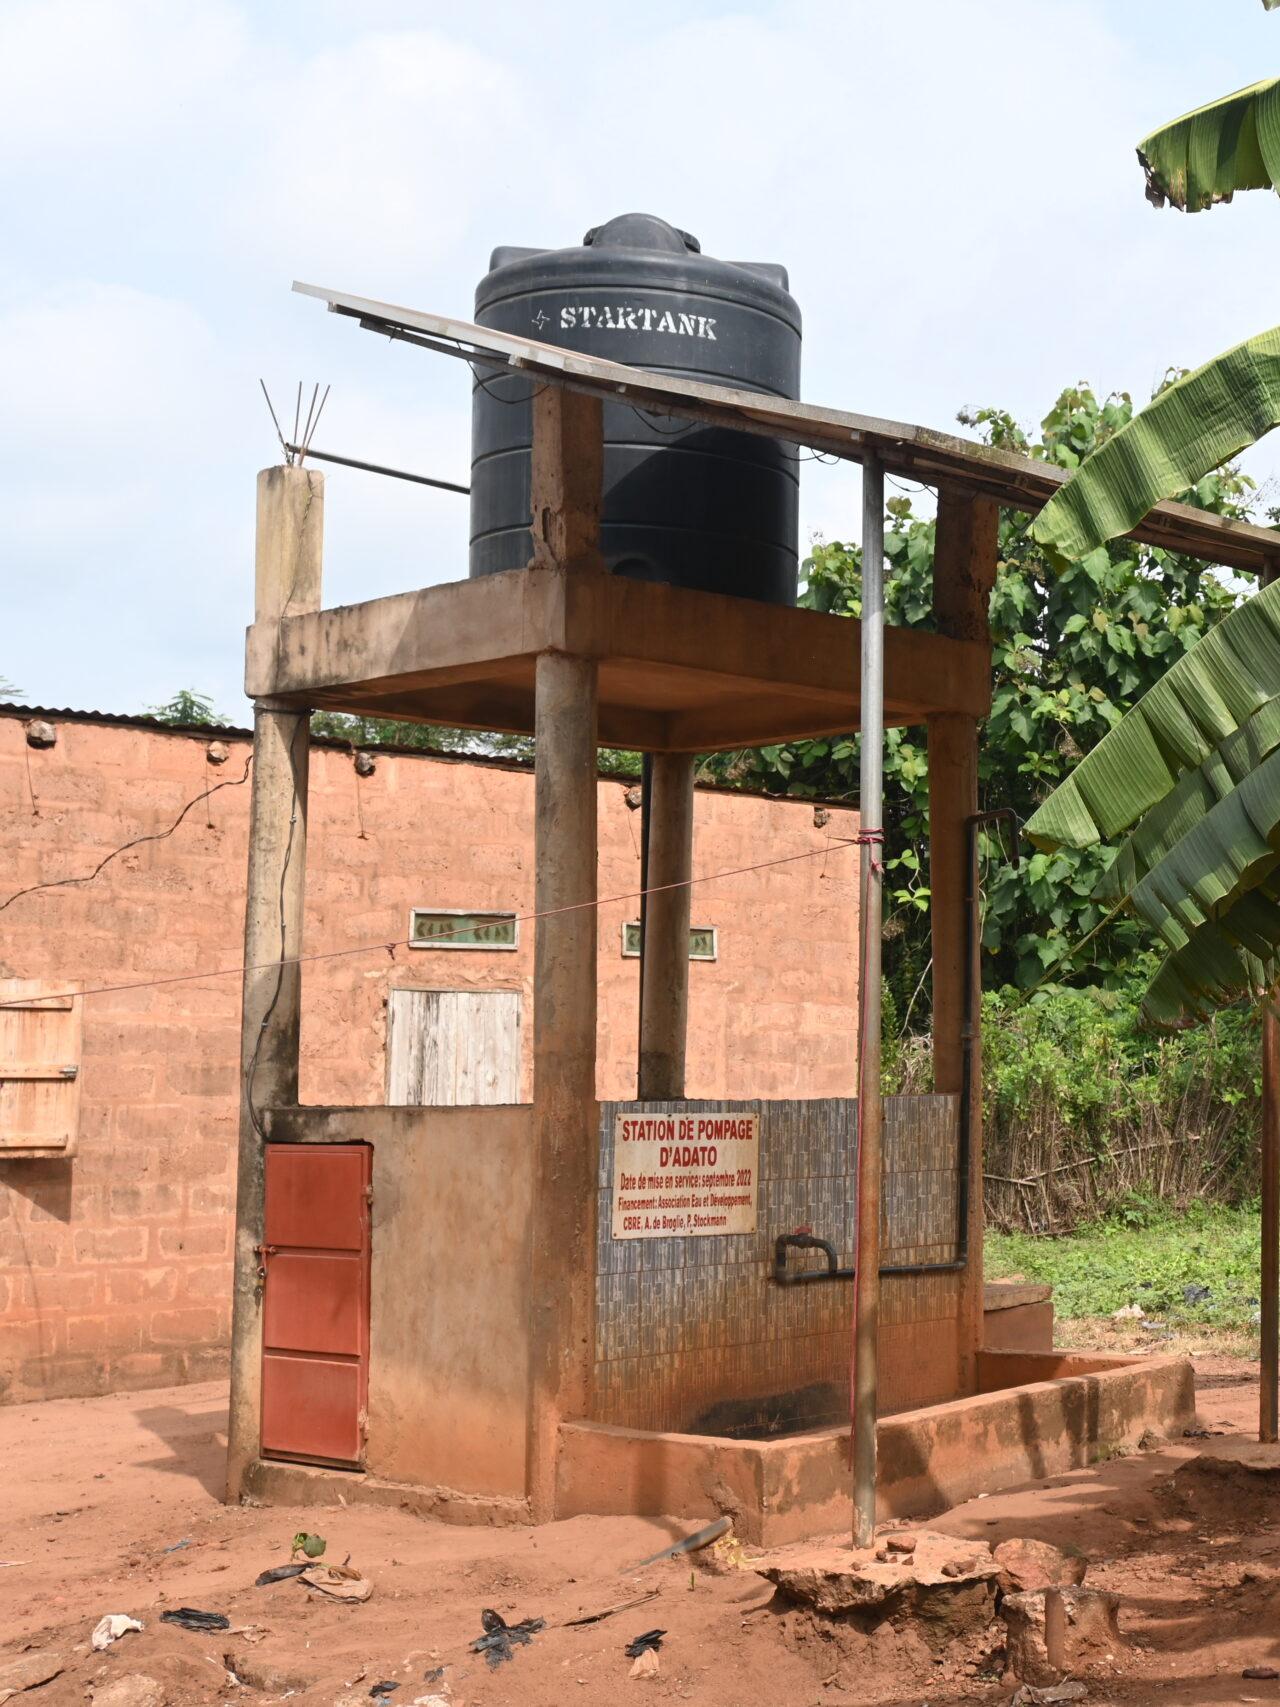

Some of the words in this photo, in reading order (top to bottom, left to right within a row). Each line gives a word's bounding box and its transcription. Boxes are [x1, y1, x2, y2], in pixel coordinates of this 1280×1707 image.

[560, 306, 717, 341] STARTANK
[622, 1120, 675, 1141] STATION
[678, 1120, 694, 1140] DE
[698, 1119, 753, 1140] POMPAGE
[659, 1145, 717, 1167] D'ADATO
[620, 1172, 636, 1190] Date
[637, 1172, 646, 1189] de
[647, 1172, 663, 1189] mise
[665, 1176, 673, 1189] en
[674, 1171, 701, 1188] service:
[701, 1170, 735, 1191] septembre
[736, 1169, 752, 1186] 2022
[618, 1196, 658, 1211] Financement:
[658, 1195, 690, 1209] Association
[691, 1194, 702, 1207] Eau
[702, 1195, 709, 1207] et
[623, 1216, 643, 1232] CBRE,
[645, 1216, 652, 1229] A.
[653, 1216, 661, 1229] de
[662, 1214, 686, 1232] Broglie,
[686, 1214, 692, 1228] P.
[693, 1214, 727, 1228] Stockmann
